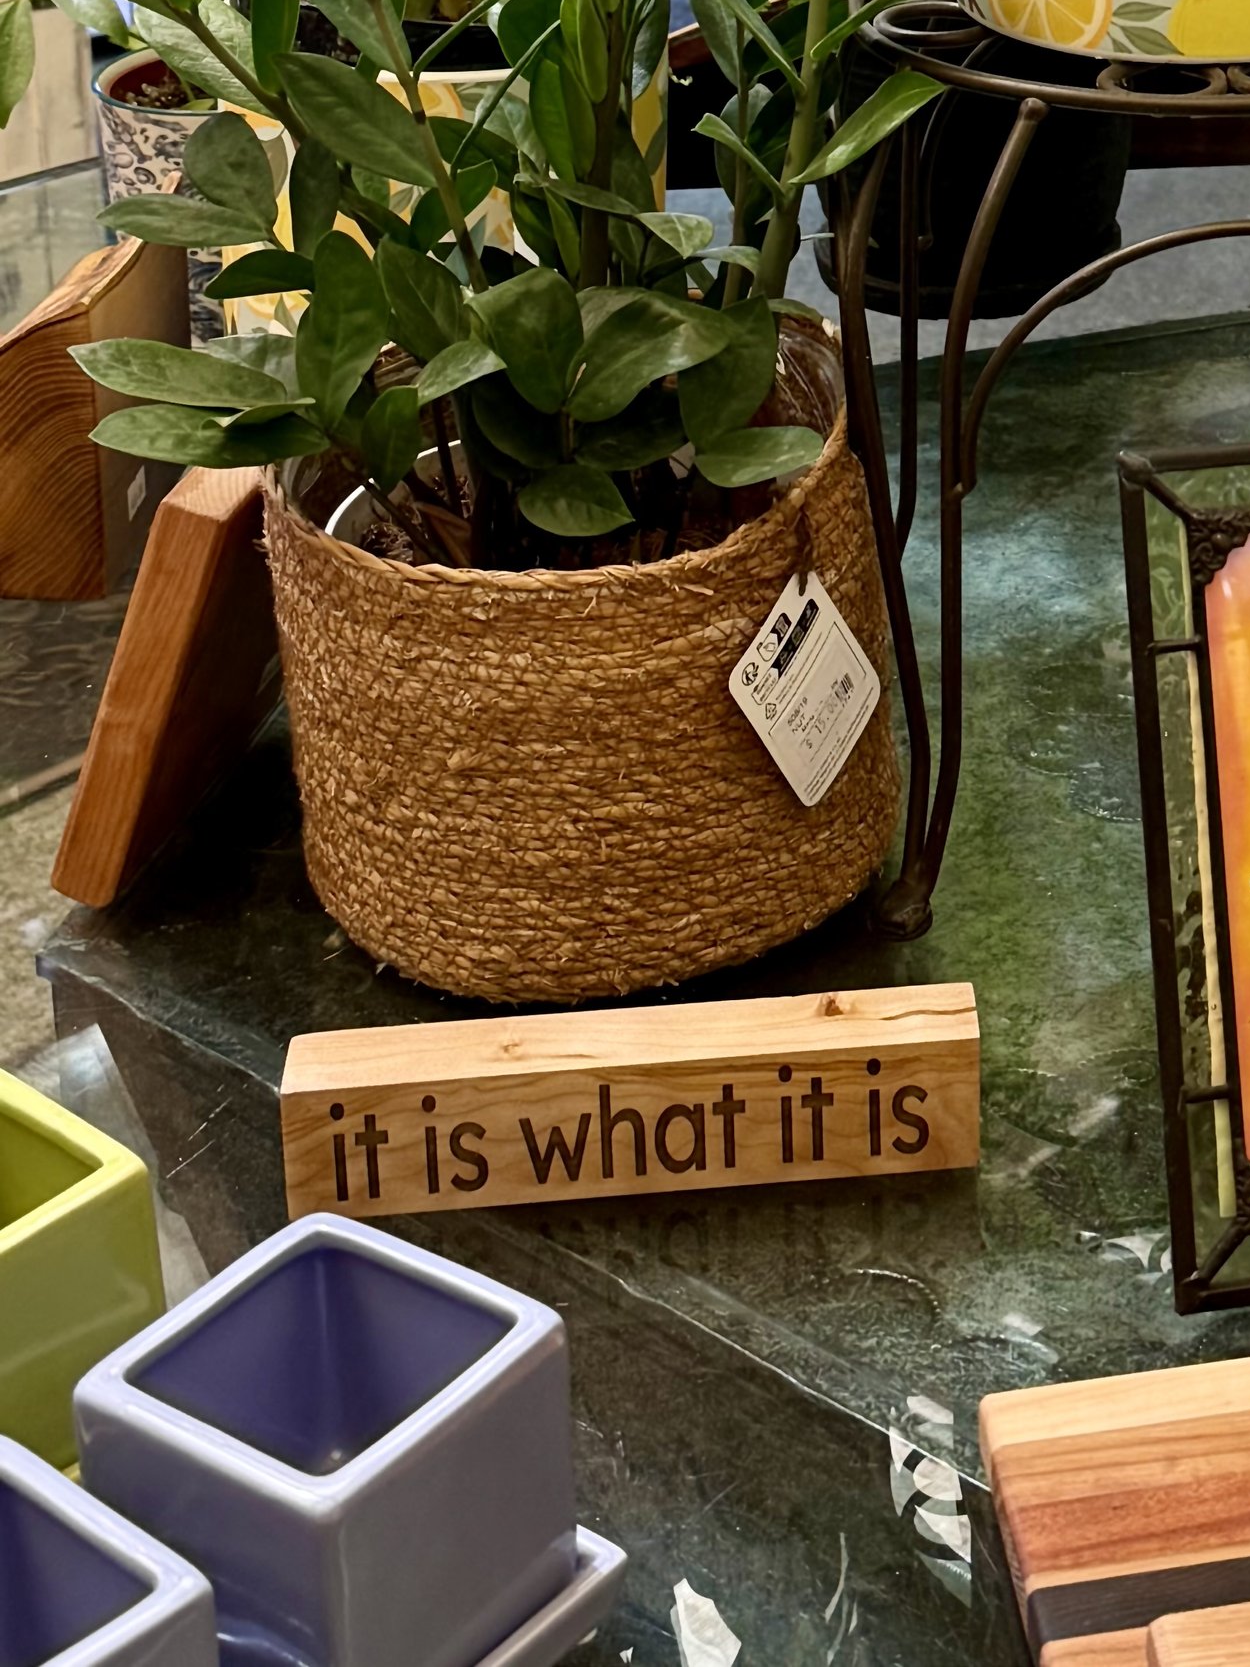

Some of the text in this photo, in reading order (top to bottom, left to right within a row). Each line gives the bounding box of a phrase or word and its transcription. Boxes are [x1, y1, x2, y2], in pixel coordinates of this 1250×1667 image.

[327, 1057, 931, 1201] it is what it is
